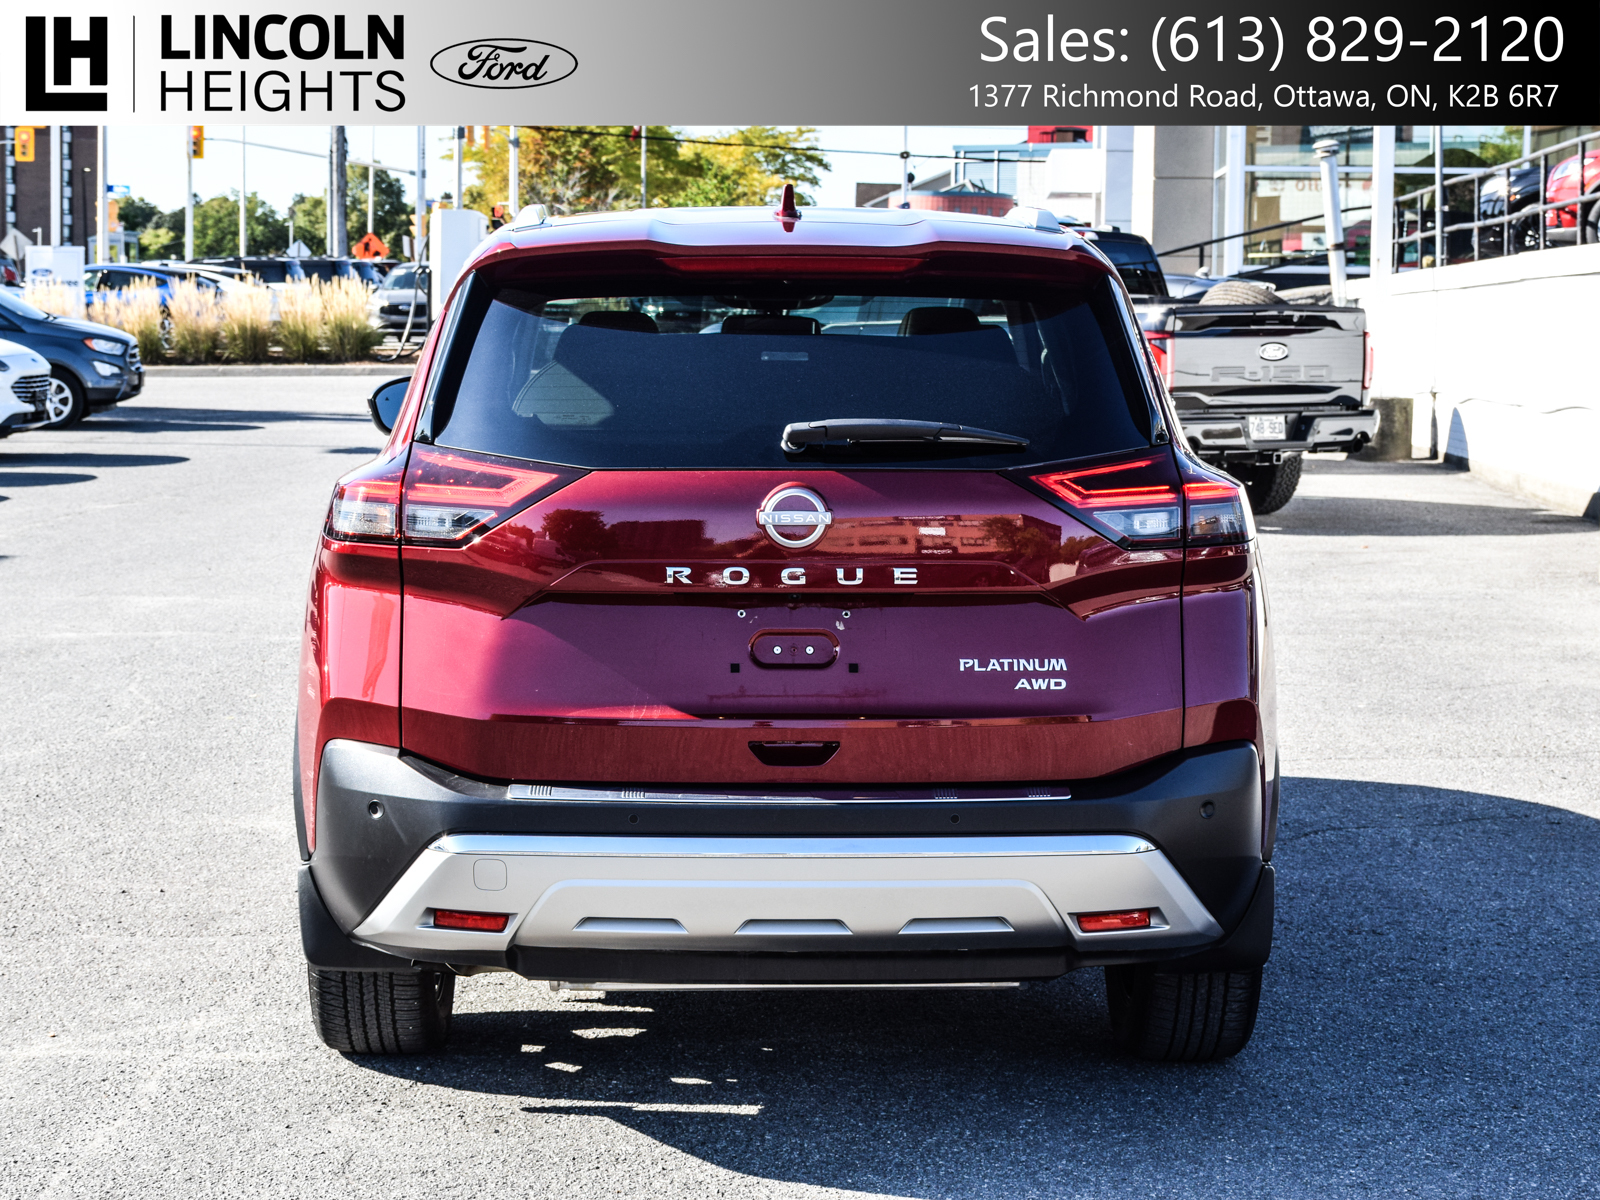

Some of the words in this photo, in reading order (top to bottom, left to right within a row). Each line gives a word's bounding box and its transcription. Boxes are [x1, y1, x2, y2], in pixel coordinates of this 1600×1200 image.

[761, 513, 830, 523] NISSAN
[664, 566, 919, 586] ROGUE
[958, 657, 1068, 672] PLATINUM
[1013, 677, 1068, 690] AWD
